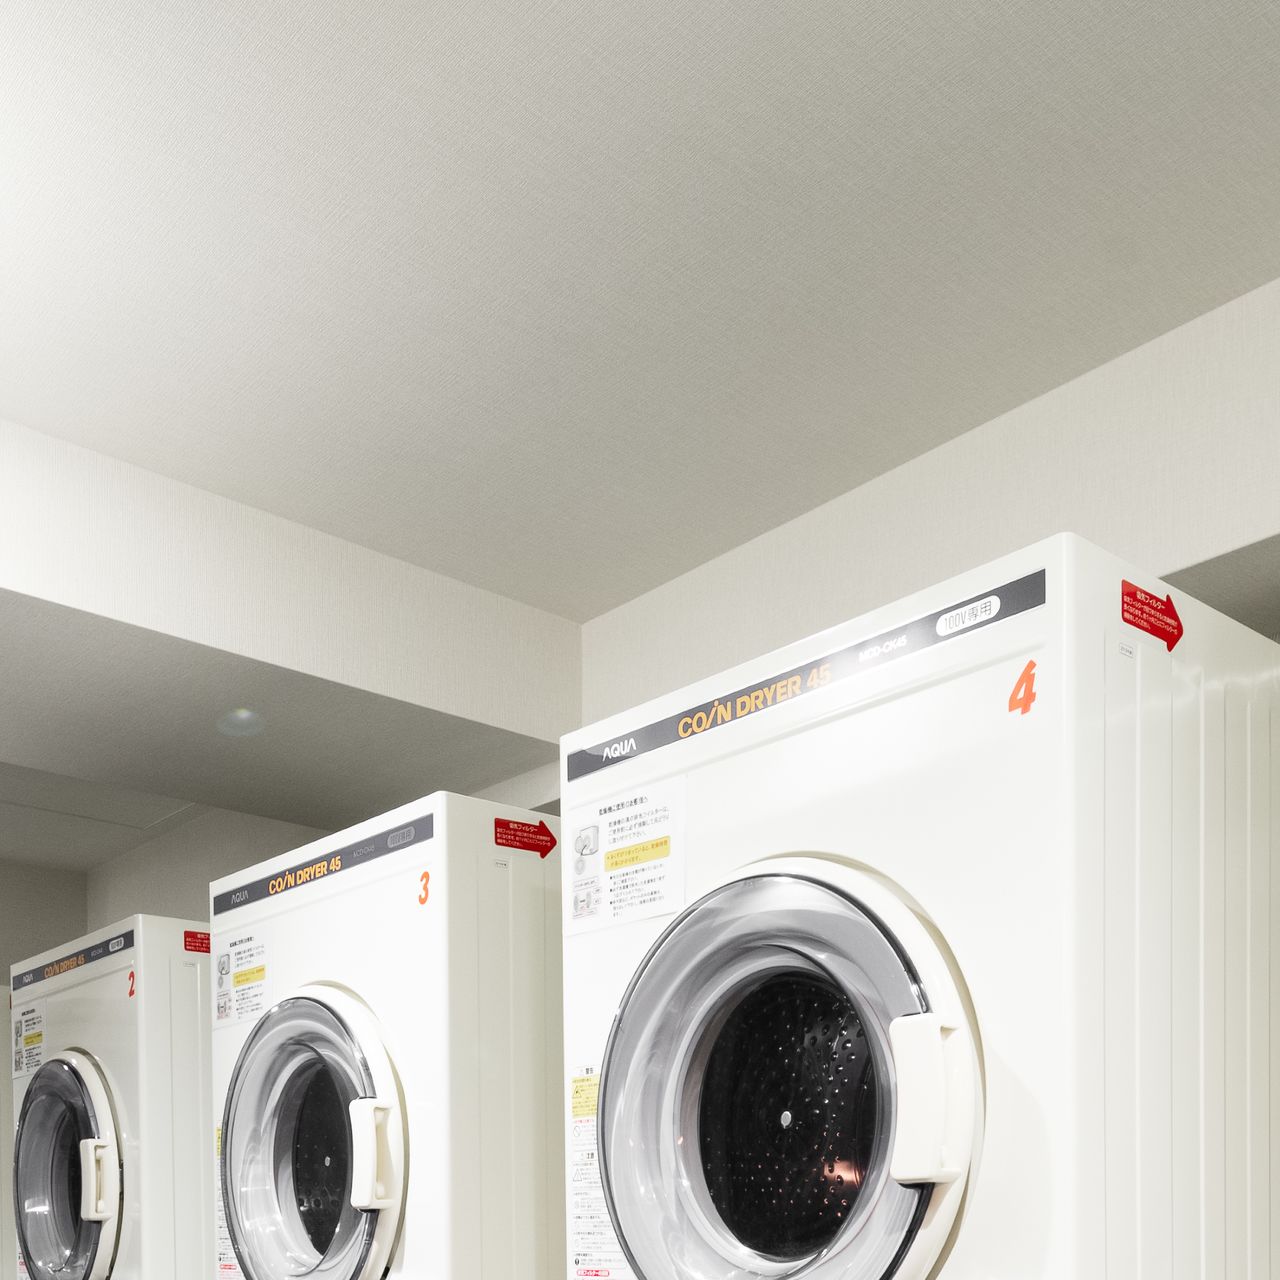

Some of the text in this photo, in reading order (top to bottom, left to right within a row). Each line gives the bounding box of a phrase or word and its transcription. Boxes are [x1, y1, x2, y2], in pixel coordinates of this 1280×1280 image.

[944, 600, 993, 631] 100V専用
[677, 663, 832, 738] COIN DRYER 45
[1008, 659, 1037, 715] 4
[602, 738, 637, 762] AQUA
[268, 855, 342, 894] COIN DRYER 45
[418, 871, 430, 905] 3
[129, 971, 135, 997] 2
